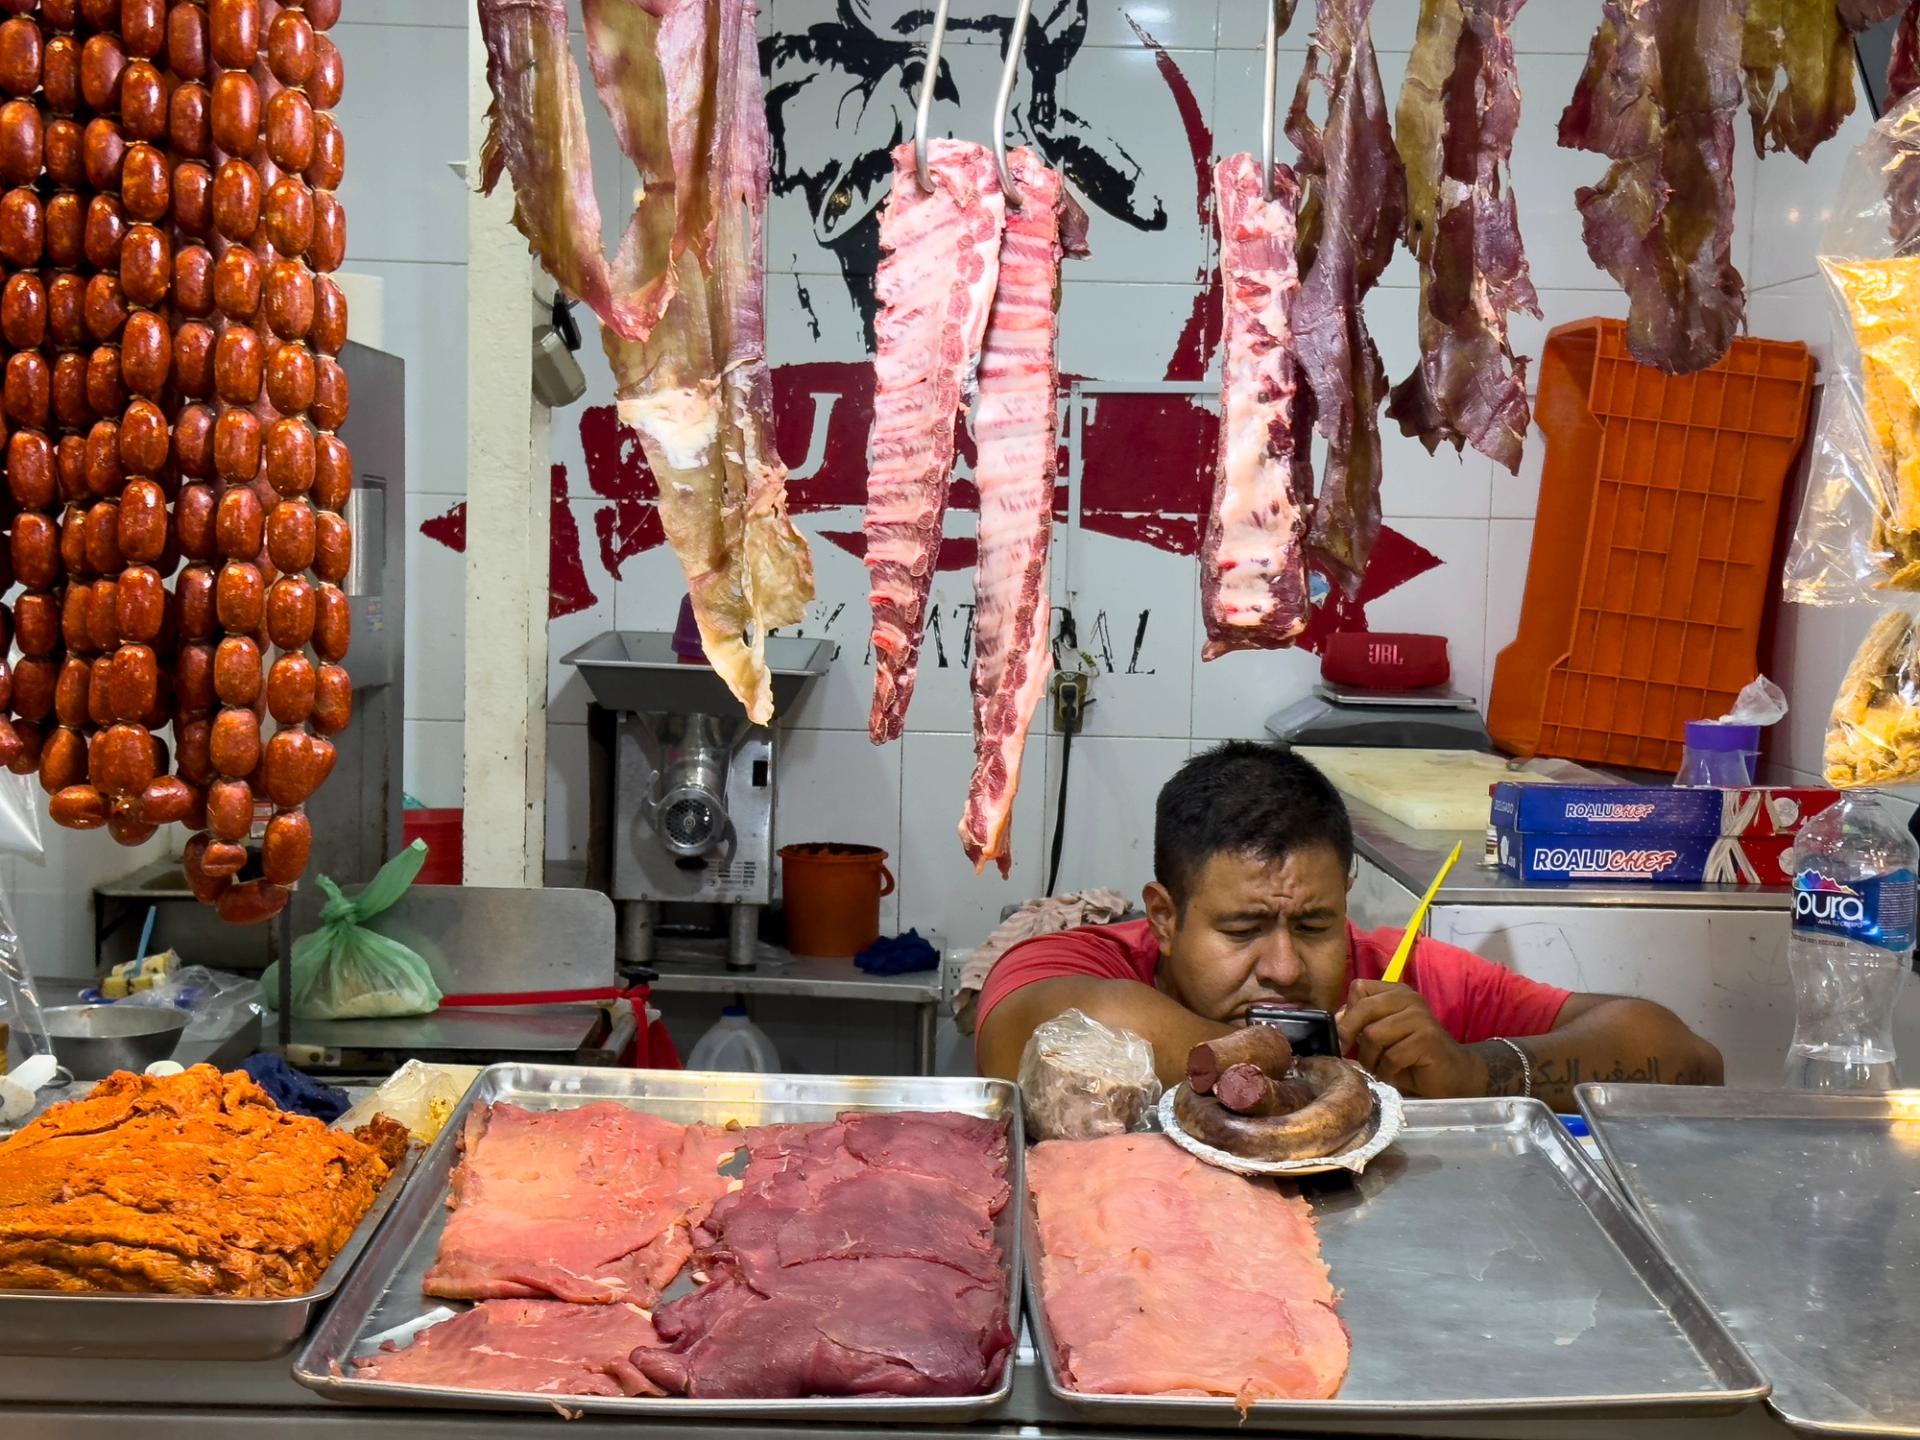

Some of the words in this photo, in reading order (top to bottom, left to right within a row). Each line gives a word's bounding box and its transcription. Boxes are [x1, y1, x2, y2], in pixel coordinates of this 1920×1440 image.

[1368, 643, 1404, 665] JBL
[1565, 803, 1655, 818] ROALUCHEF
[1533, 848, 1676, 871] ROALUCHEF
[1792, 891, 1864, 920] pura
